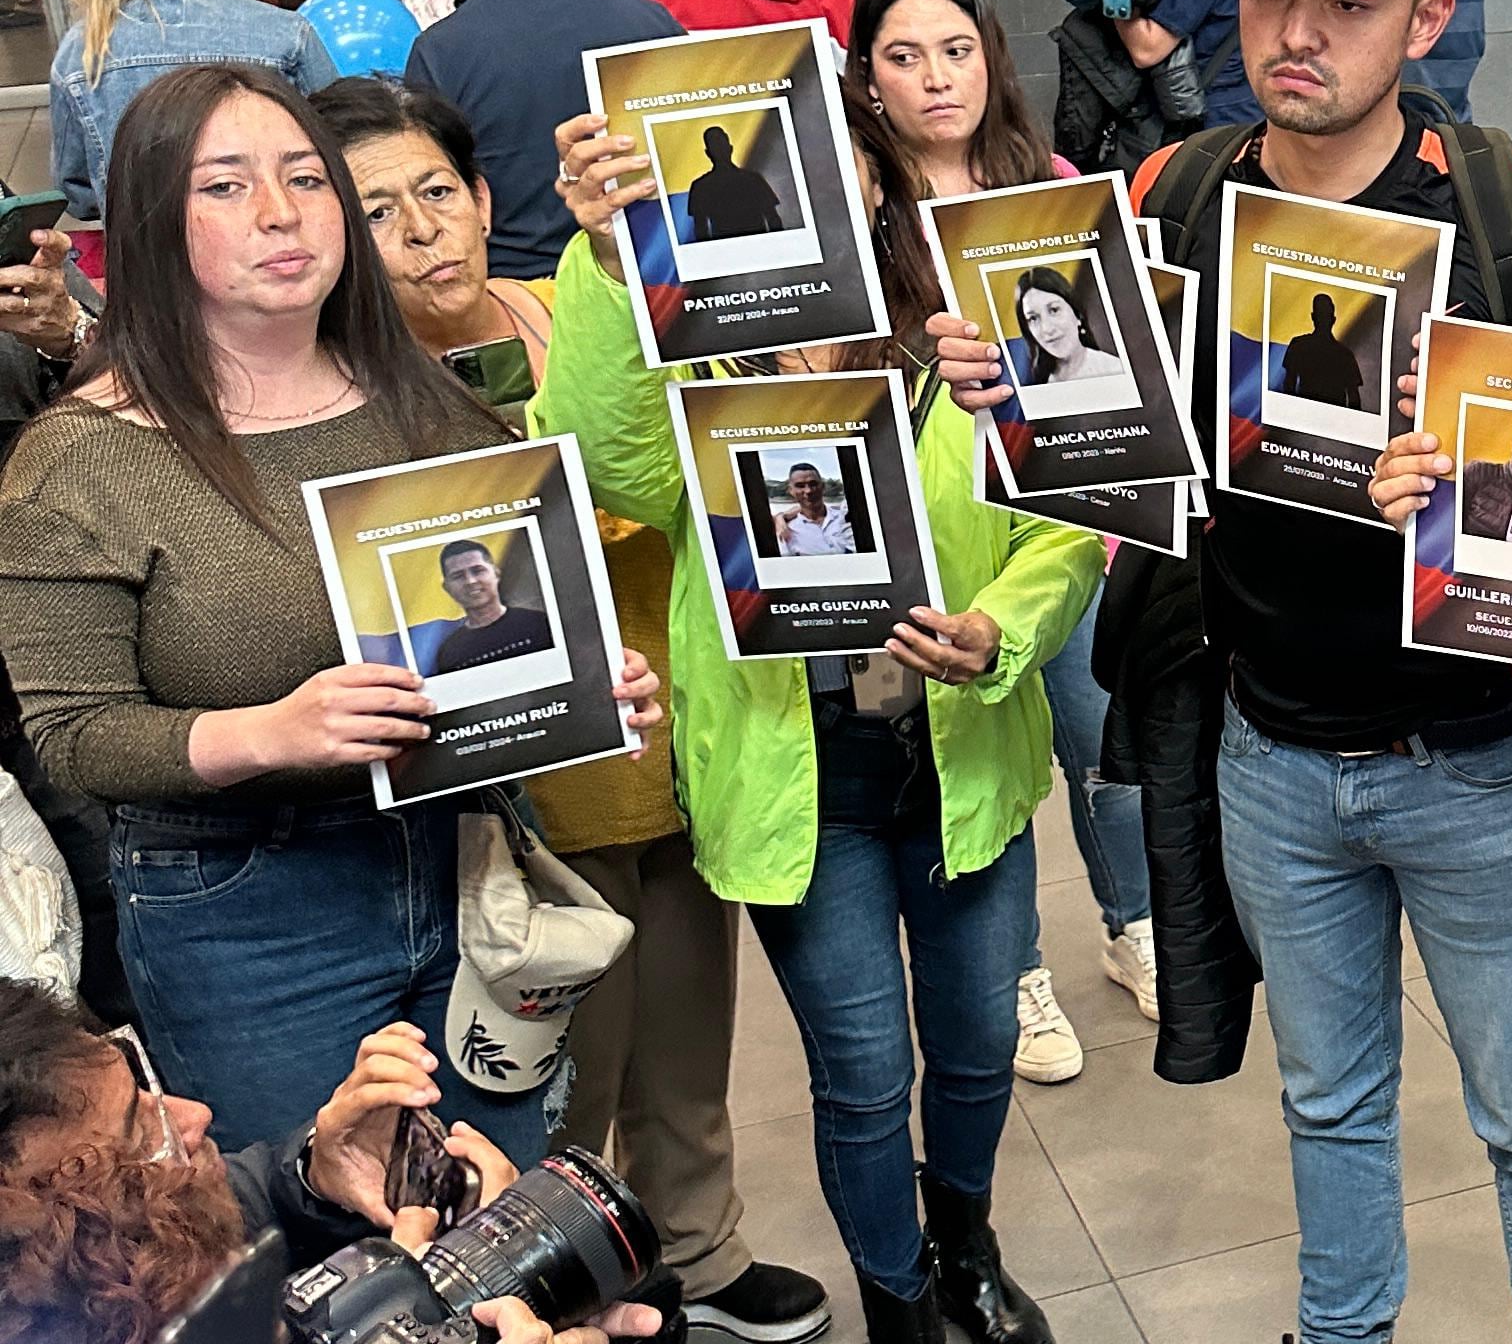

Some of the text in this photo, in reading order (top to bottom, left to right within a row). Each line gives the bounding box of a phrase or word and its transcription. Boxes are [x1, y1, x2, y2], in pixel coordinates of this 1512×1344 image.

[624, 78, 792, 111] SECUESTRADO POR EL ELN
[962, 230, 1100, 259] SECUESTRADO POR EL ELN
[1252, 242, 1406, 282] SECUESTRADO POR EL ELN
[683, 281, 832, 312] PATRICIO PORTELA
[710, 421, 868, 438] SECUESTRADO POR EL ELN
[1034, 425, 1150, 447] BLANCA PUCHANA
[1261, 441, 1376, 477] EDWAR MONSALV
[356, 497, 541, 542] SECUESTRADO POR EL ELN
[770, 600, 890, 614] EDGAR GUEVARA
[435, 712, 528, 744] JONATHAN
